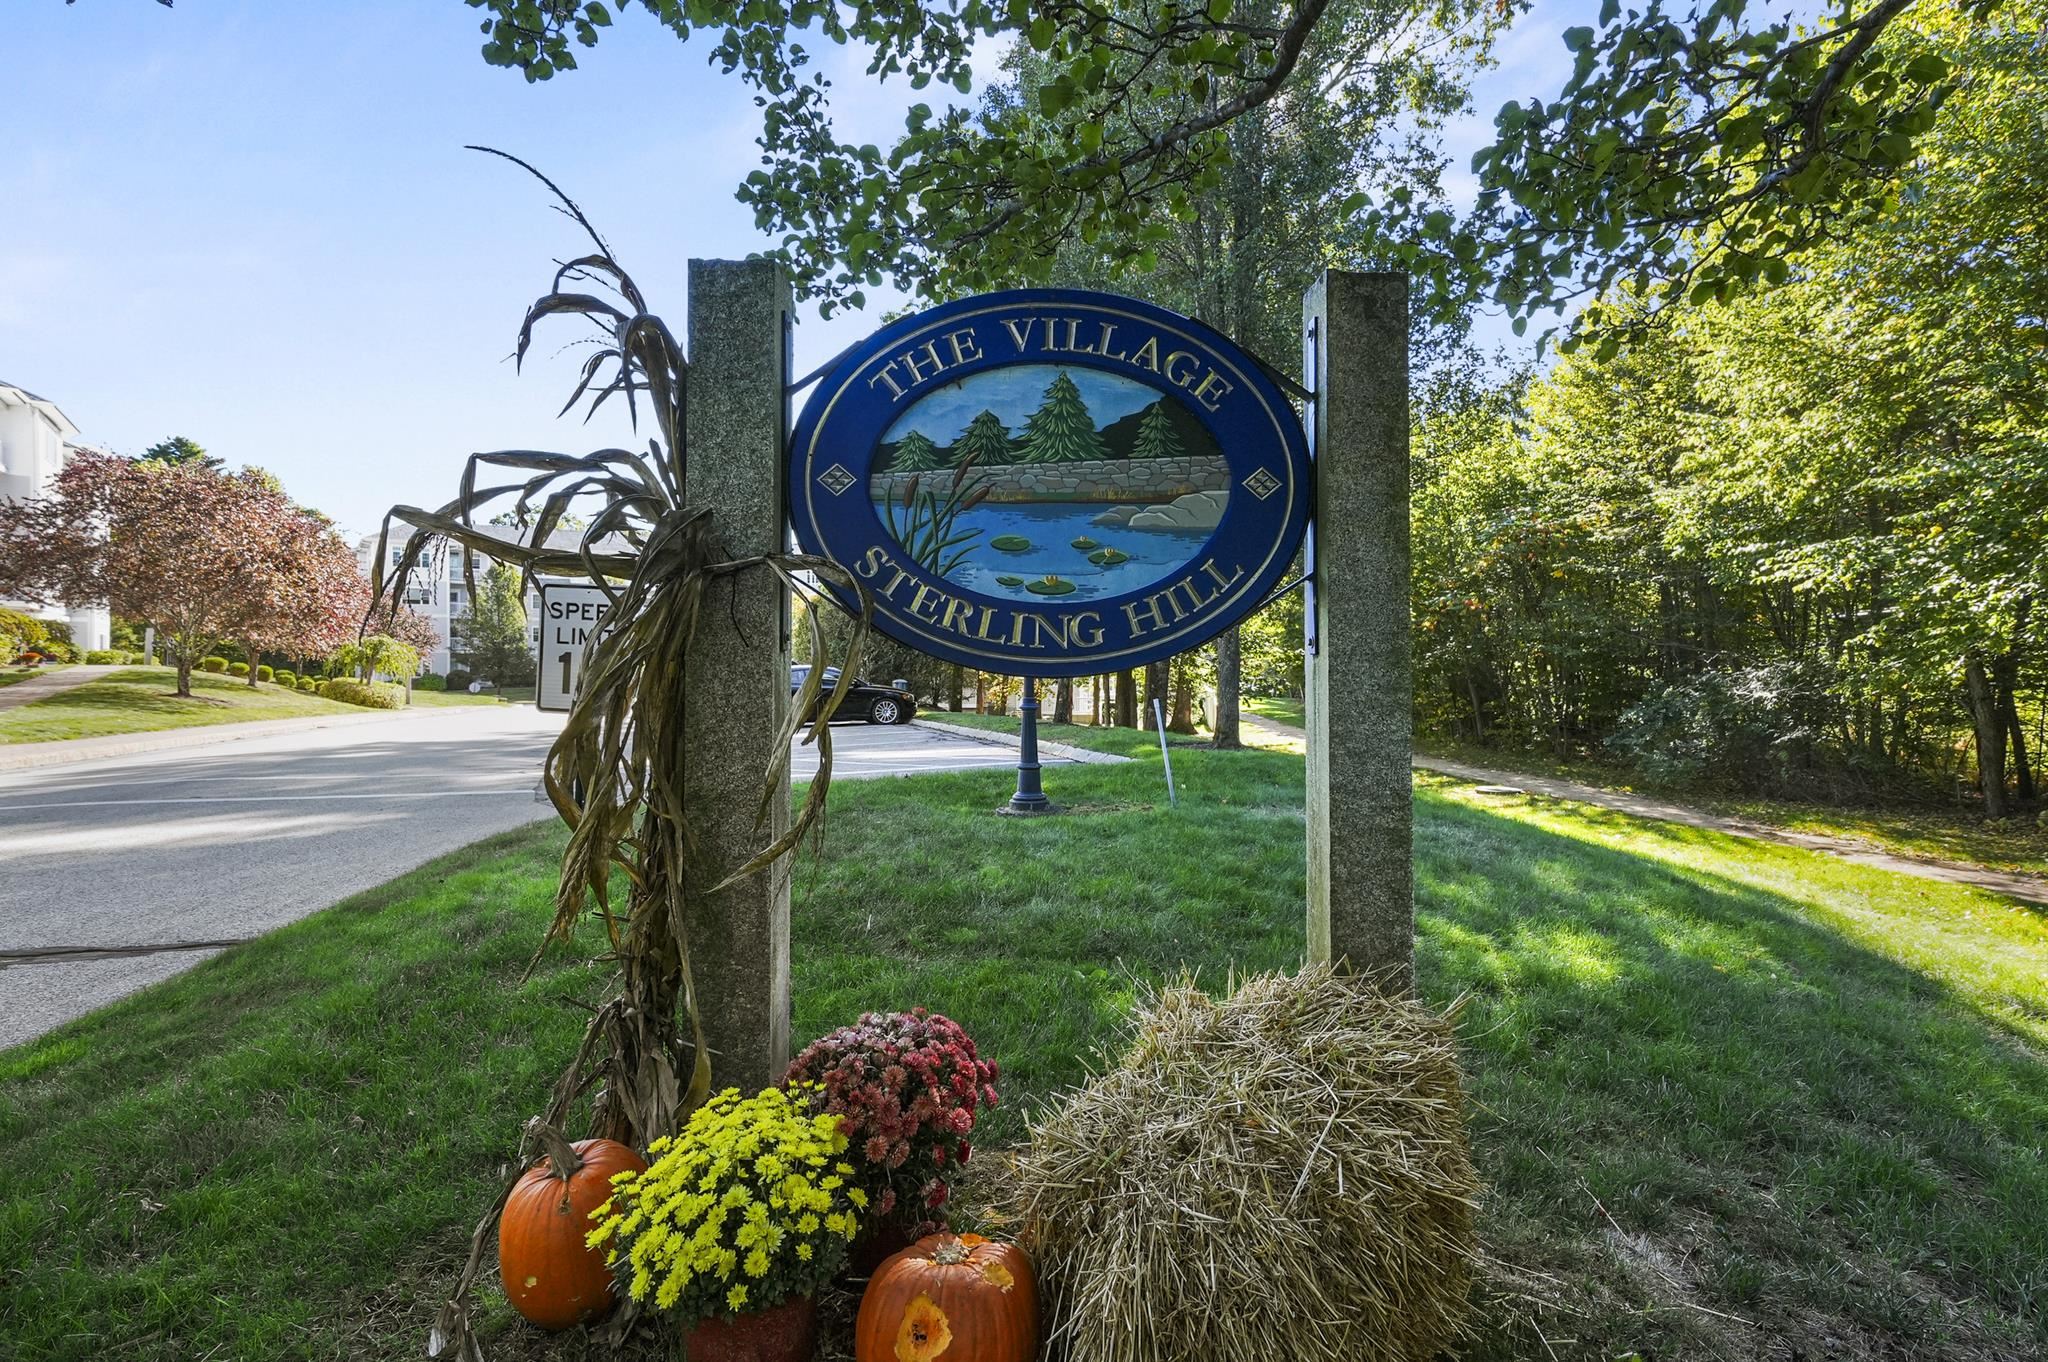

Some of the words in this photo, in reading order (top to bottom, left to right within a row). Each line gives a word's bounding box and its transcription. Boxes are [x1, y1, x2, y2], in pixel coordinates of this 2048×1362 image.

[868, 328, 984, 402] THE
[1001, 317, 1234, 413] VILLAGE
[551, 602, 610, 620] SPEE
[855, 545, 1105, 649] STERLING
[1120, 558, 1245, 639] HILL
